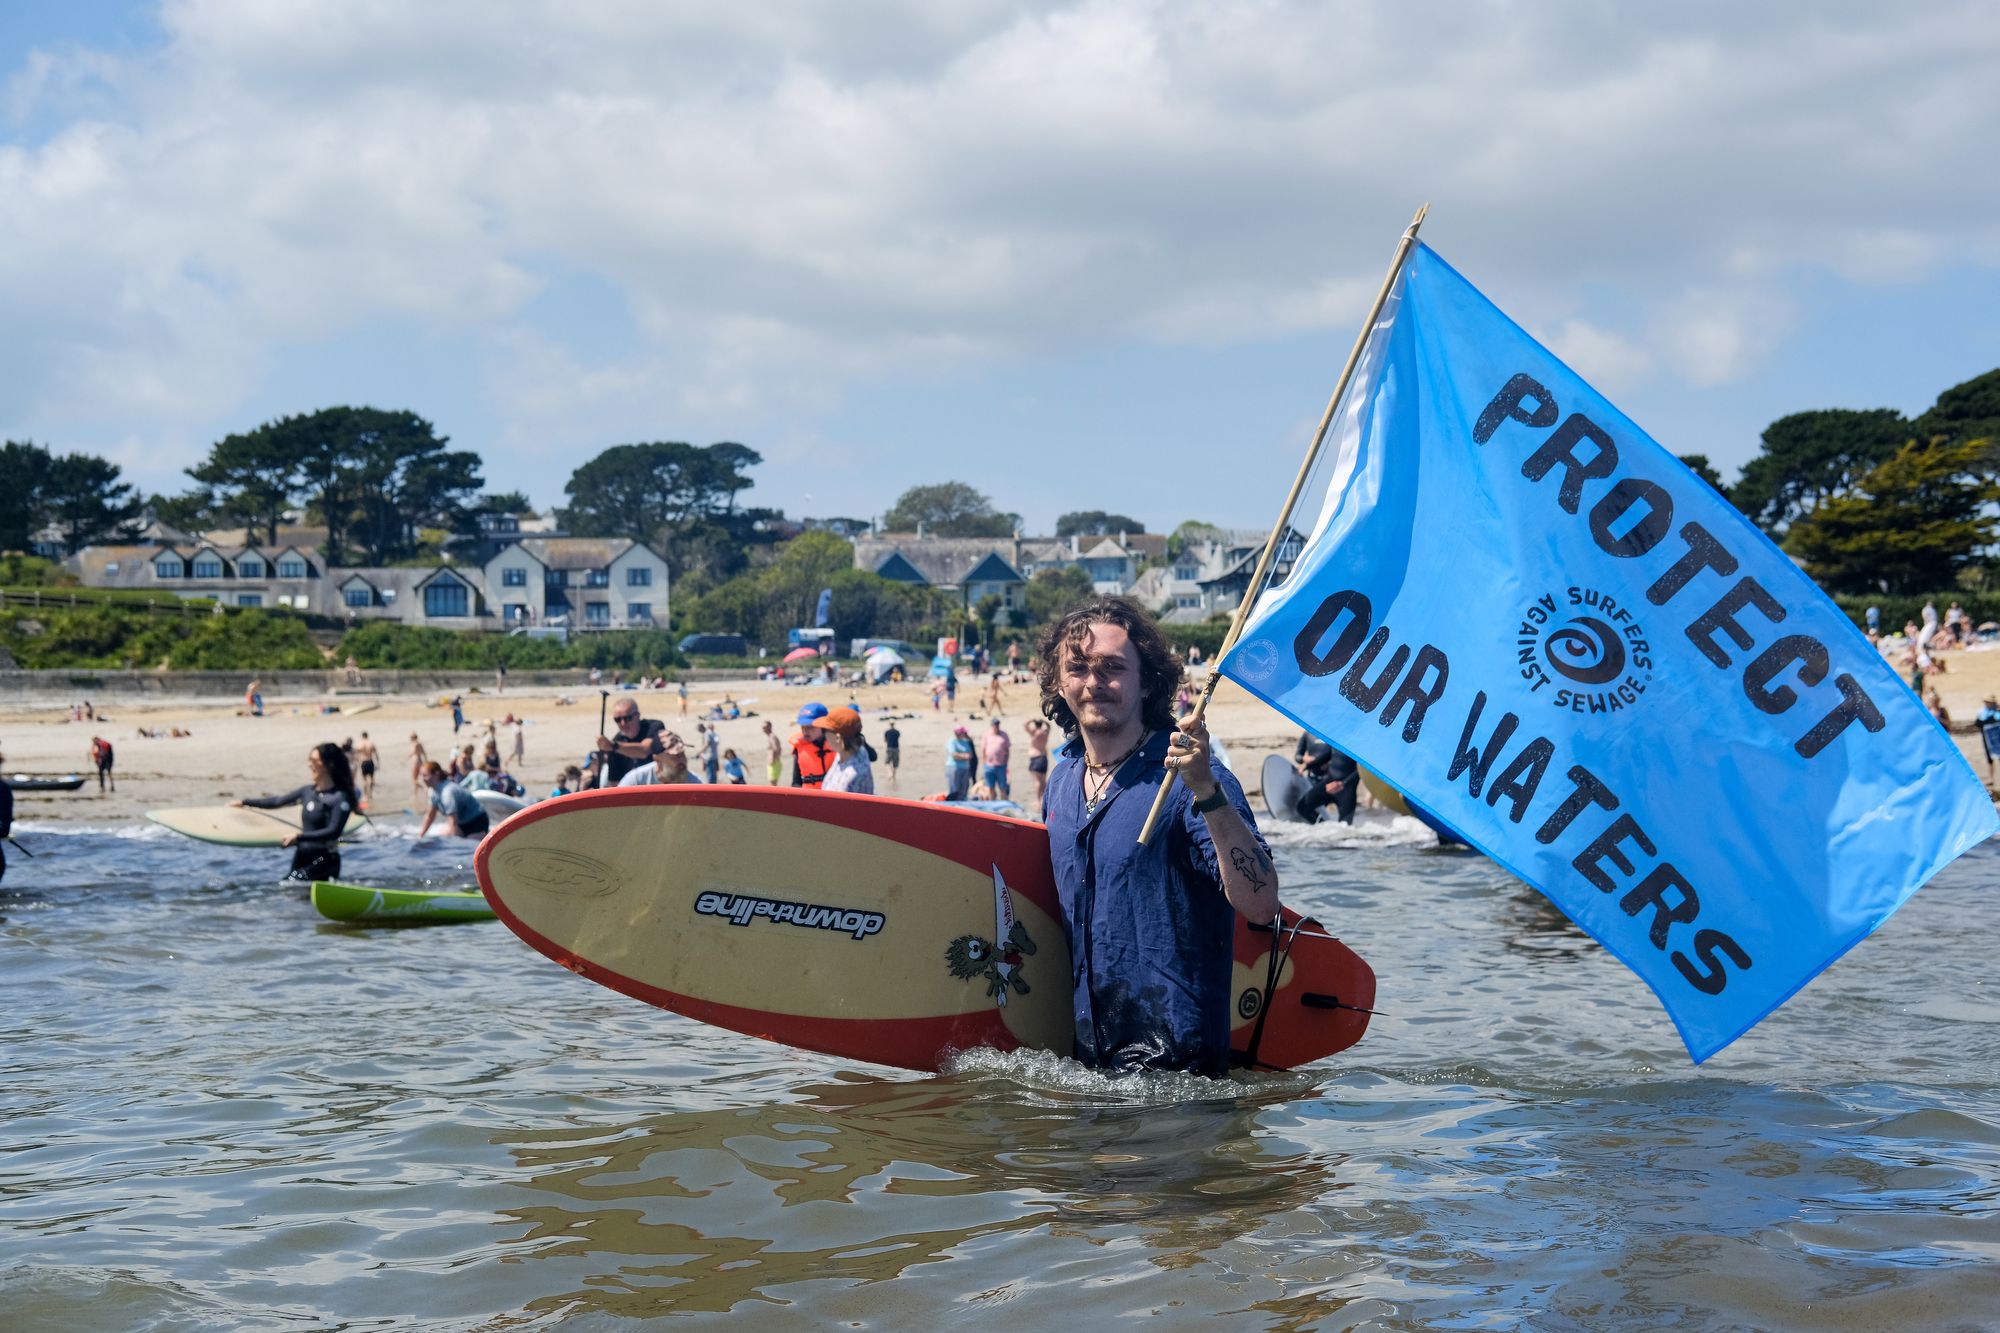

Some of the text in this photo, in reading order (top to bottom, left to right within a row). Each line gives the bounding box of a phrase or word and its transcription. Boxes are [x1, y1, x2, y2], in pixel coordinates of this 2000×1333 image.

[1474, 373, 1885, 759] PROTECT
[1517, 586, 1652, 714] SURFERS AGAINST SEWAGE
[1293, 590, 1753, 996] OUR WATERS
